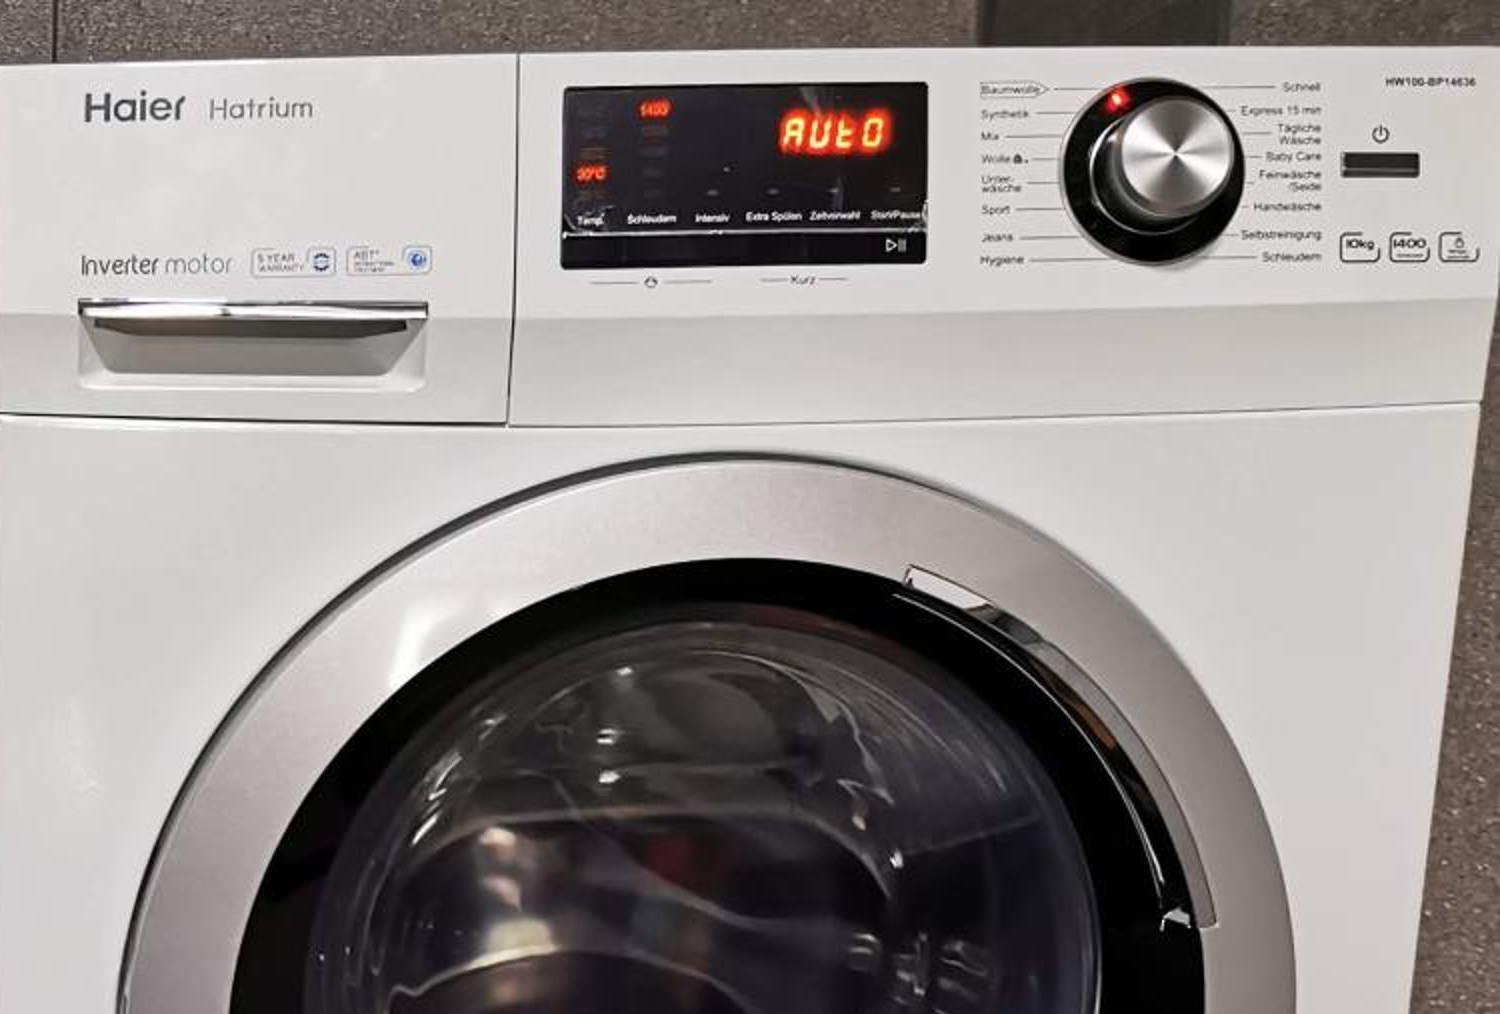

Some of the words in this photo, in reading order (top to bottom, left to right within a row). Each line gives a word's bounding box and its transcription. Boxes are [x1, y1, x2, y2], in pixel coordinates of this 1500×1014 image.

[1283, 82, 1321, 92] Schnell
[83, 90, 186, 123] Haier
[208, 96, 314, 120] Hatrium
[1241, 105, 1283, 117] Express
[1287, 105, 1300, 115] 15
[981, 132, 999, 140] Mix
[1266, 151, 1293, 163] Baby
[1295, 151, 1322, 161] Care
[981, 205, 1011, 215] Sport
[695, 213, 730, 223] Intensiv
[745, 211, 769, 221] Extra
[981, 233, 1013, 242] Jeans
[267, 253, 295, 262] YEAR
[979, 256, 1025, 266] Hygiene
[81, 253, 159, 275] Inverter
[165, 254, 233, 274] motor
[790, 275, 816, 285] Kurz
